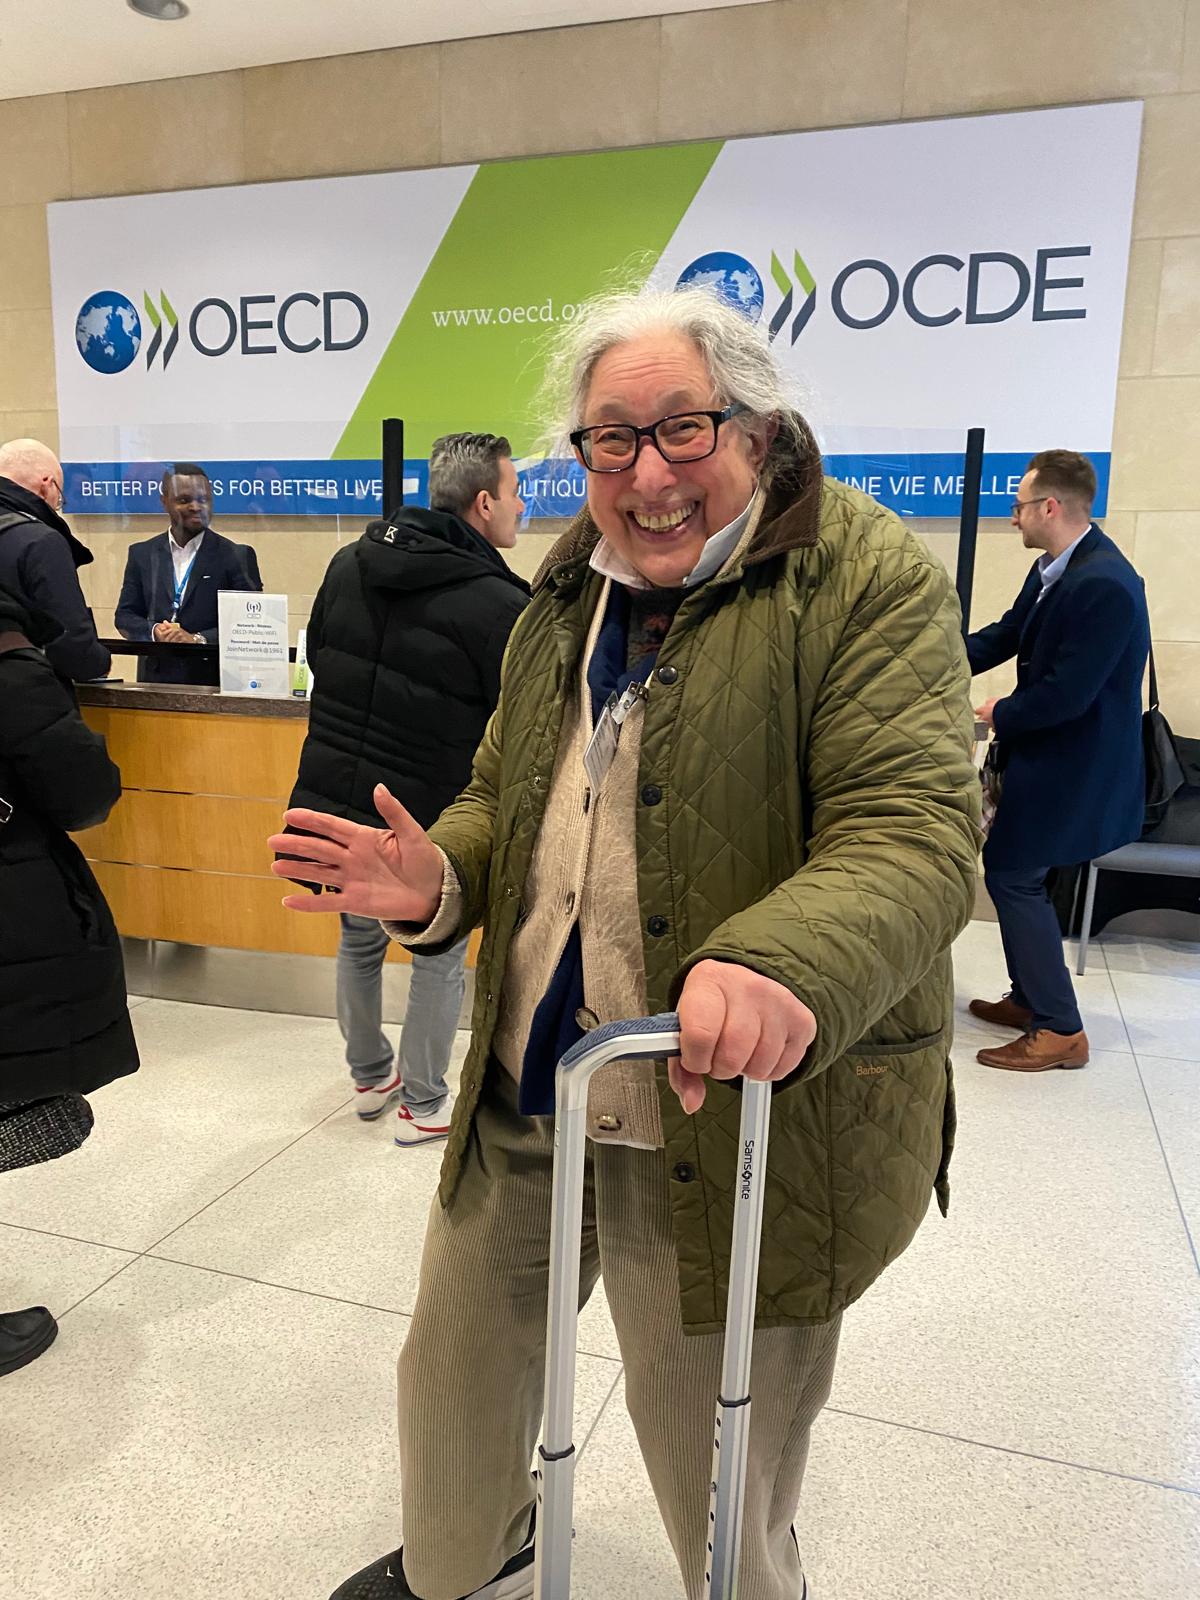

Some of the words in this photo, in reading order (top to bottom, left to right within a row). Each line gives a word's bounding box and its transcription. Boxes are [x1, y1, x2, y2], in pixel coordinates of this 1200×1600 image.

[831, 246, 1091, 330] OCDE
[189, 291, 369, 357] OECD
[432, 298, 587, 327] www.oecd.or
[81, 481, 143, 496] BETTER
[229, 479, 264, 496] FOR
[270, 479, 339, 496] BETTER
[344, 479, 383, 496] LIVE
[517, 479, 586, 498] LITIQU
[889, 476, 926, 496] VIE
[933, 475, 1022, 495] MELLE
[856, 1064, 889, 1076] Barbour
[741, 1140, 755, 1200] Samsonite
